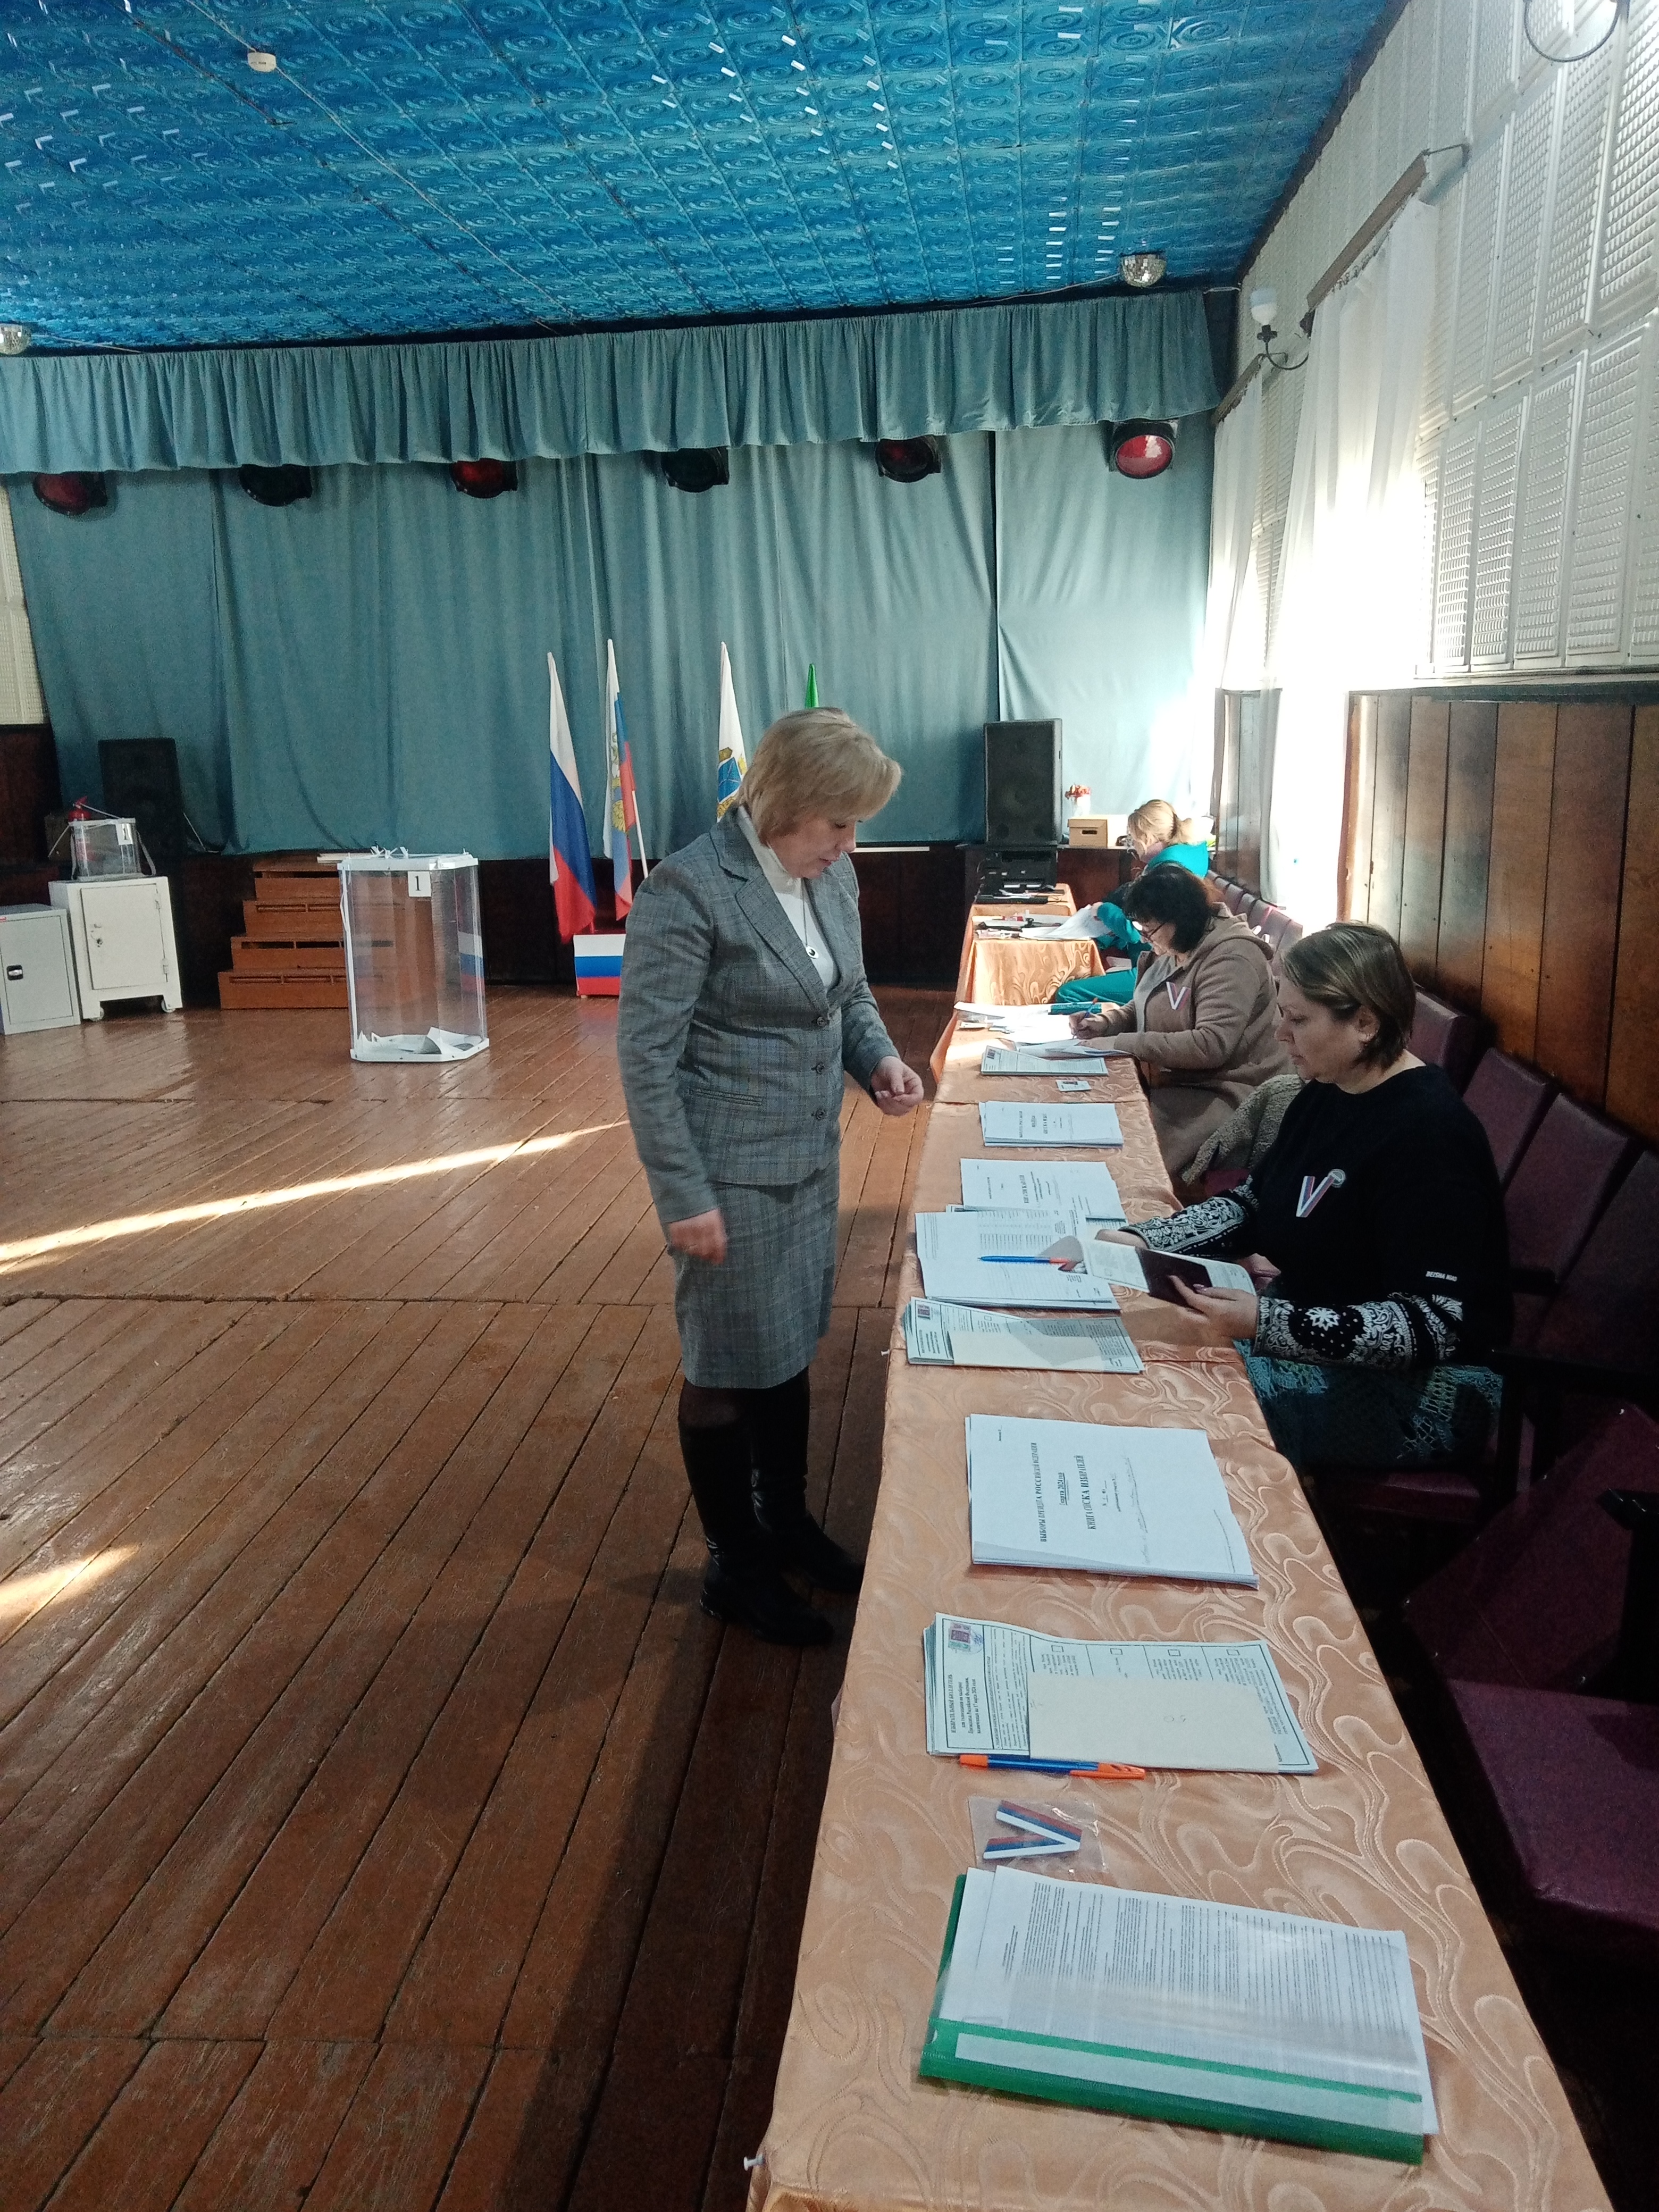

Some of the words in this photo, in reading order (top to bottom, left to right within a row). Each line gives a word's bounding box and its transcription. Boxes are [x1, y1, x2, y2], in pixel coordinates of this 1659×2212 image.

[123, 827, 128, 840] 1
[414, 875, 421, 891] 1
[1084, 1511, 1096, 1530] КНИГА
